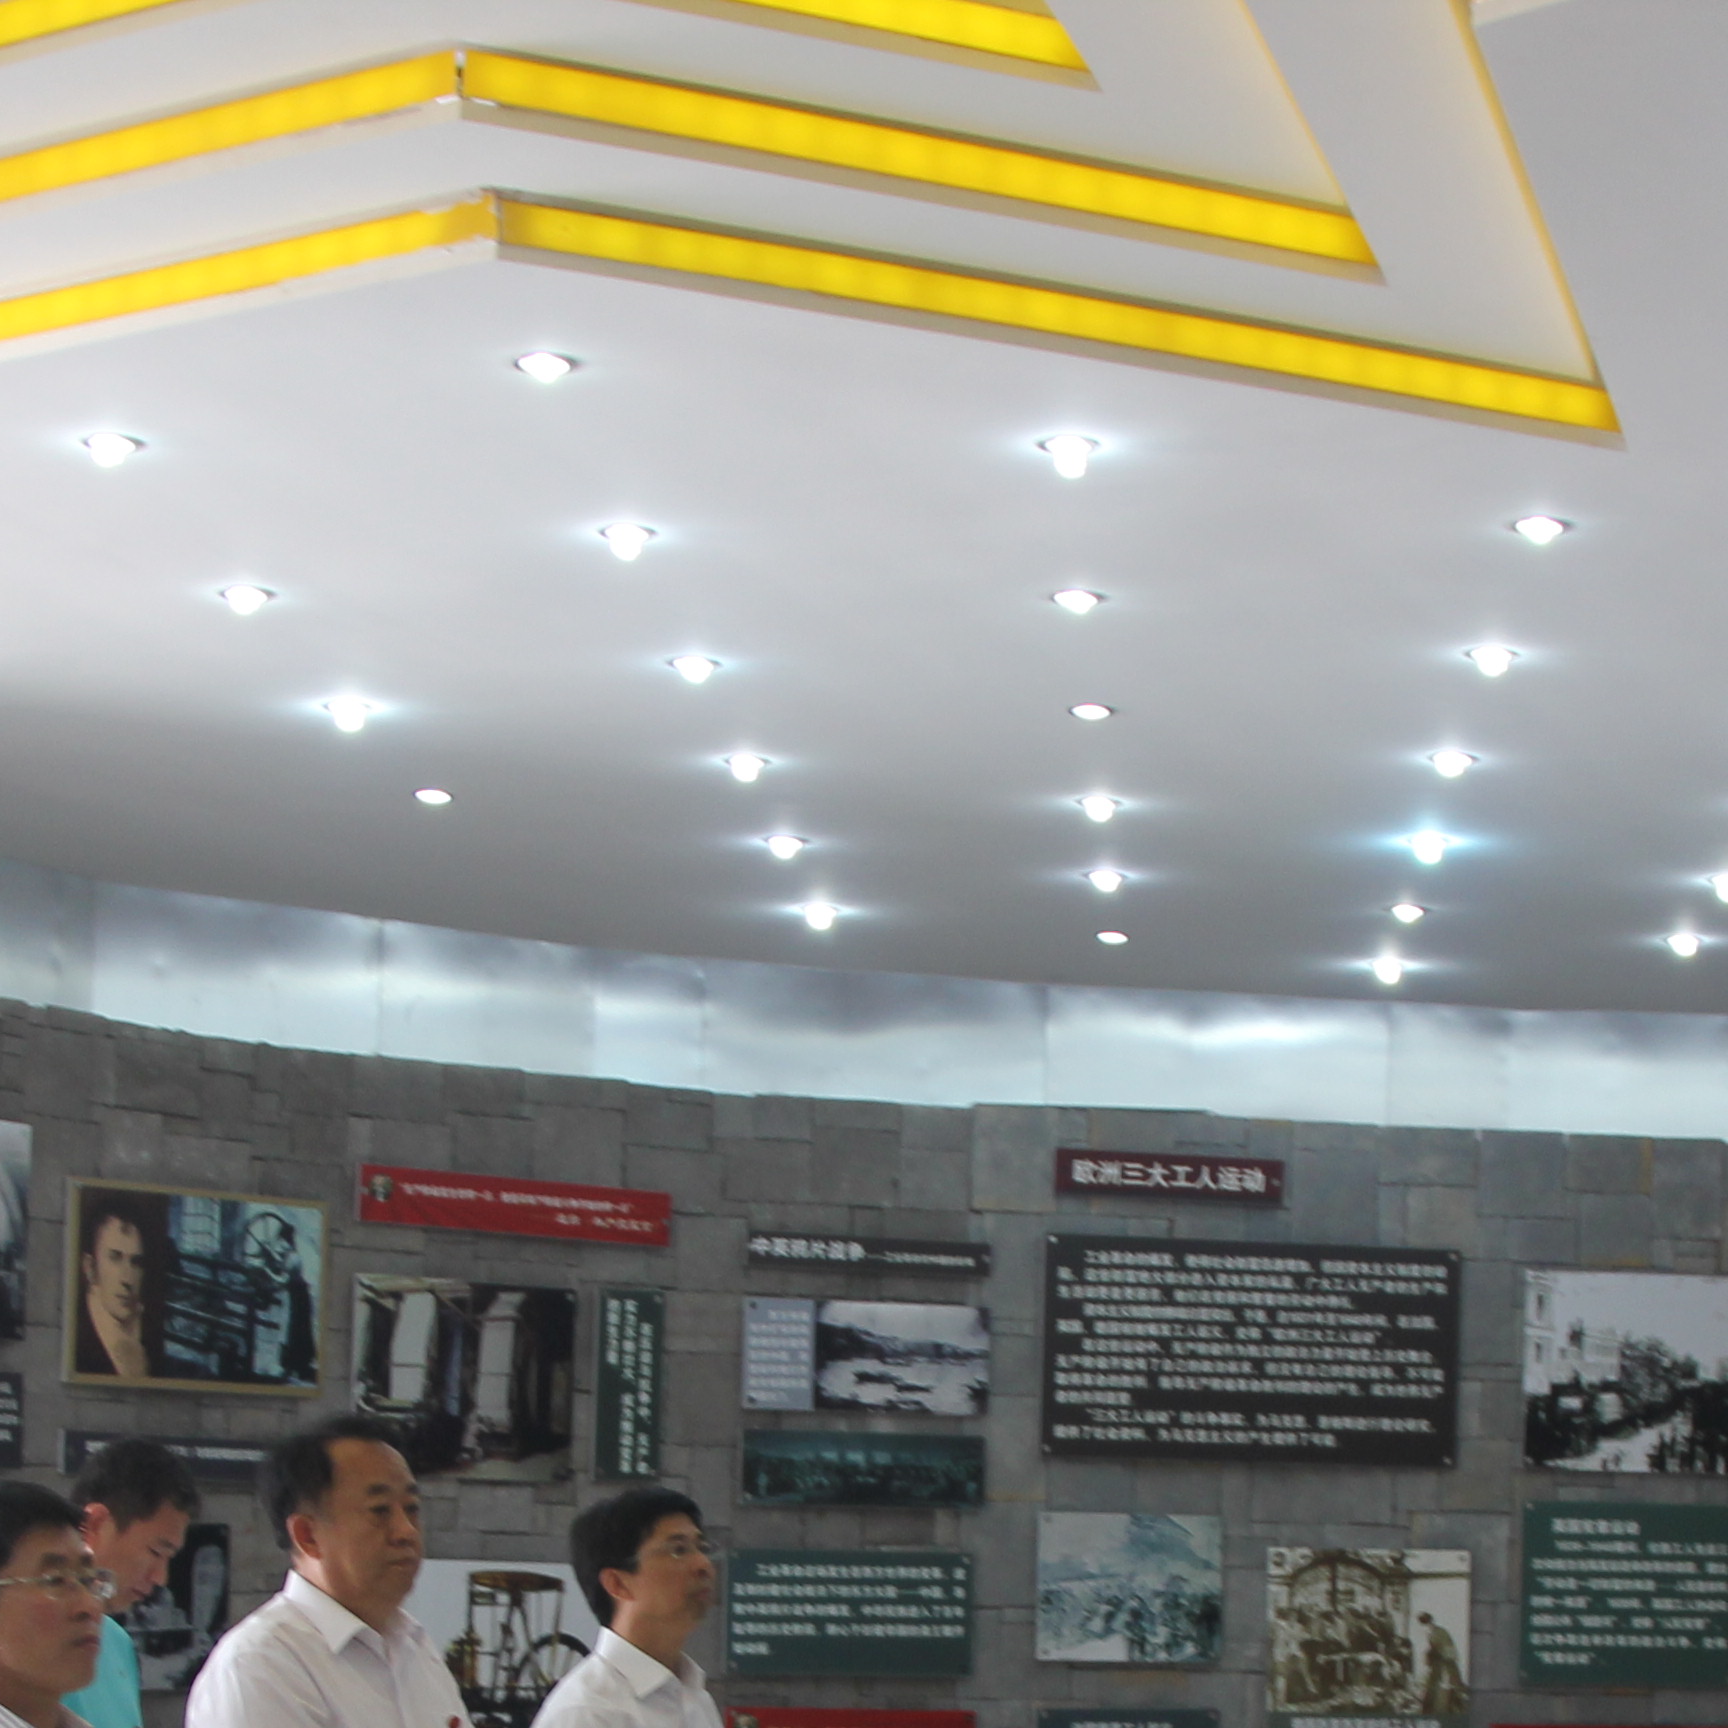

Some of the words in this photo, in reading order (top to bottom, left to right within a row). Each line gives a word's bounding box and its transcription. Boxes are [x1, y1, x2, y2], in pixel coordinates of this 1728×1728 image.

[1072, 1158, 1267, 1194] 欧洲三大工人运动
